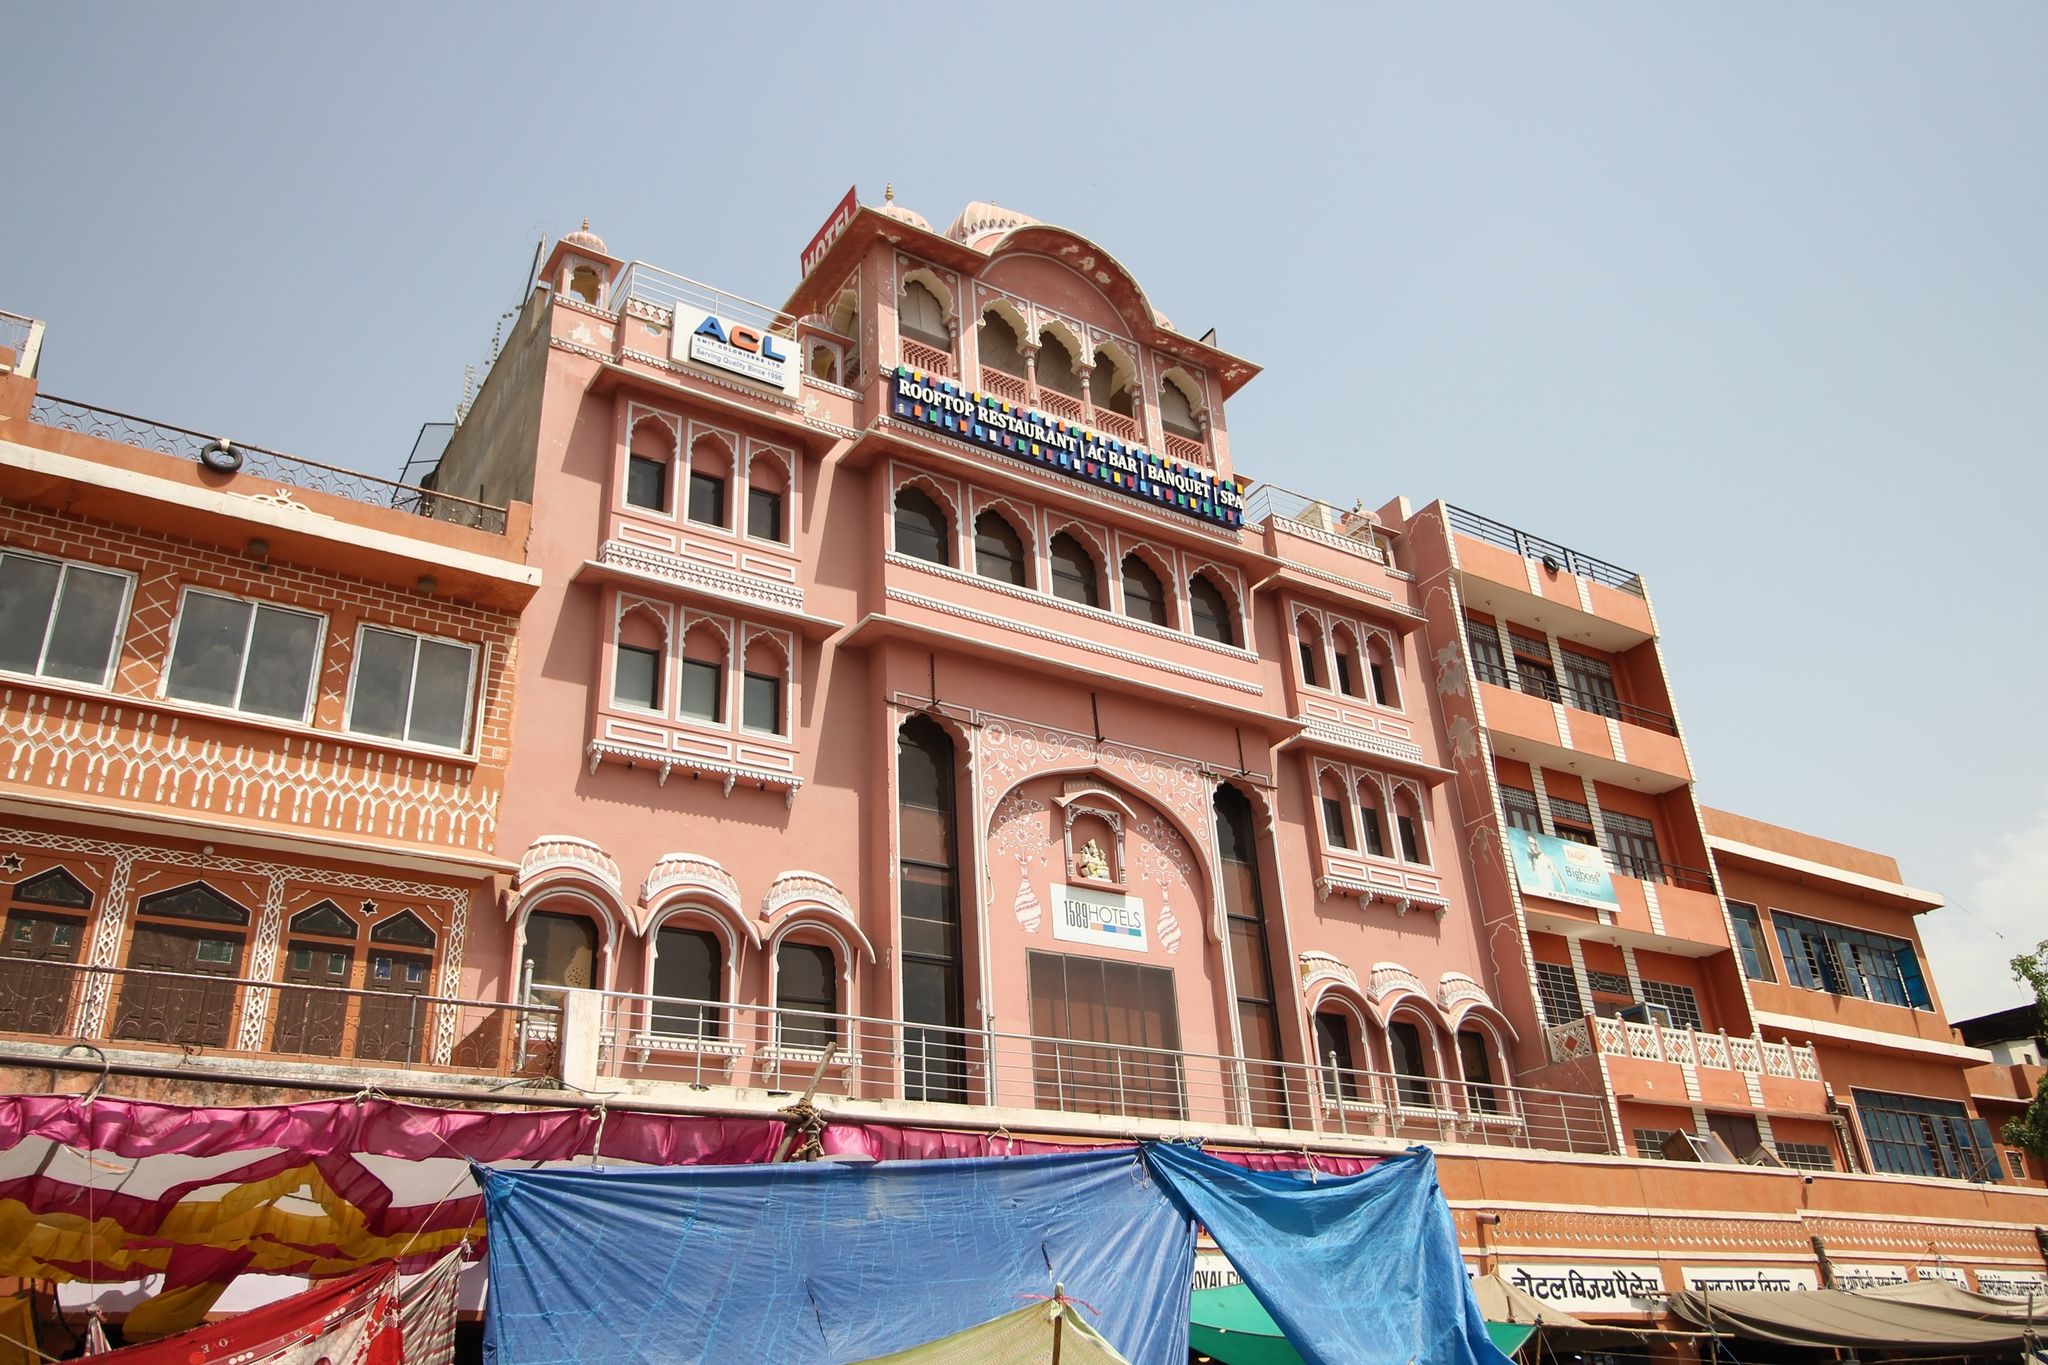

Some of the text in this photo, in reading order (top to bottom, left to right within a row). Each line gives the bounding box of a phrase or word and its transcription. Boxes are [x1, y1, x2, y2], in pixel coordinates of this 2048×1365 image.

[694, 315, 786, 363] ACL
[697, 337, 715, 347] AMIT
[696, 347, 722, 363] Serving
[723, 356, 746, 371] Quality
[747, 364, 766, 376] Since
[898, 379, 974, 417] ROOFTOP
[977, 405, 1077, 452] RESTAURANT
[1087, 444, 1106, 463] AC
[1108, 450, 1138, 474] BAR
[1147, 464, 1211, 499] BANQUET
[1220, 489, 1244, 510] SPA
[1565, 866, 1600, 883] Bigboss
[1191, 1270, 1222, 1290] OYAL
[1511, 1268, 1567, 1299] होटल
[1568, 1269, 1614, 1300] विजय
